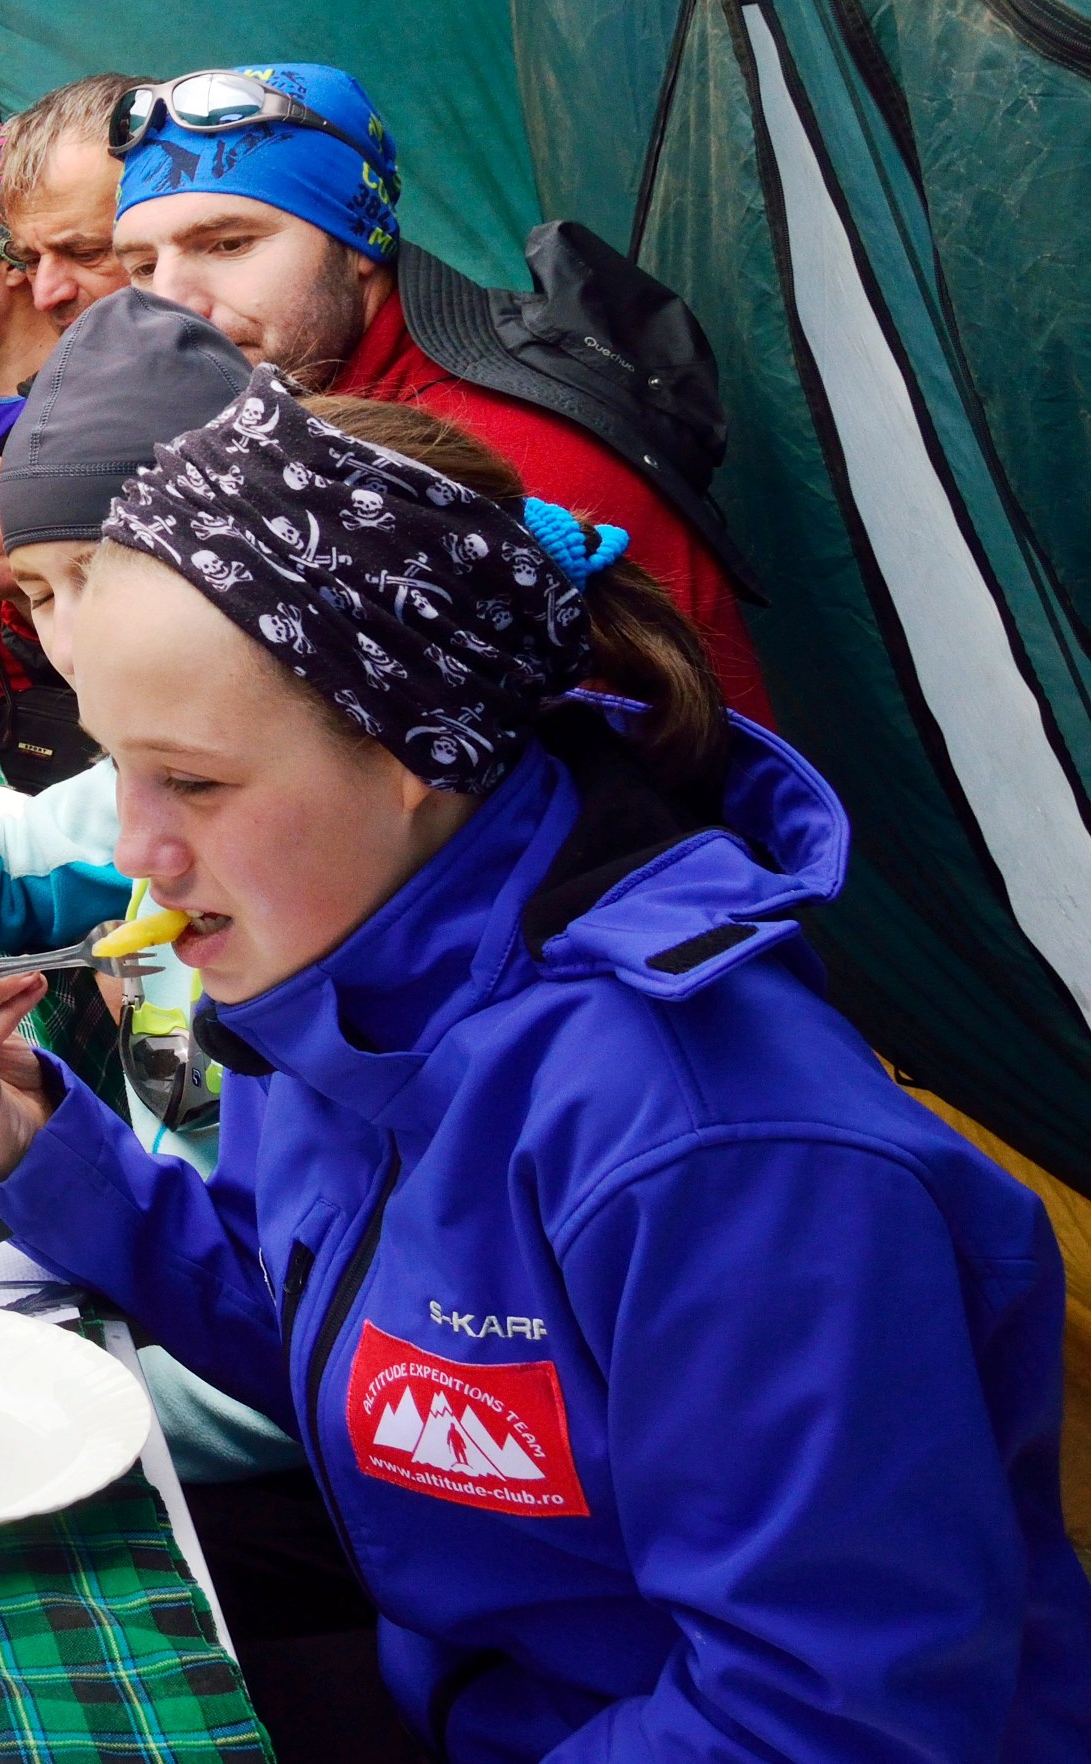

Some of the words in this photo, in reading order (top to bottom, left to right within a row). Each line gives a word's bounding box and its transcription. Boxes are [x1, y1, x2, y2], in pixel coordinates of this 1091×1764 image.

[584, 336, 635, 372] Quechua
[363, 1362, 407, 1415] ALTITUDE
[410, 1363, 504, 1413] EXPEDITIONS
[506, 1410, 546, 1458] TEAM
[369, 1455, 564, 1505] www.altitude-club.ro
